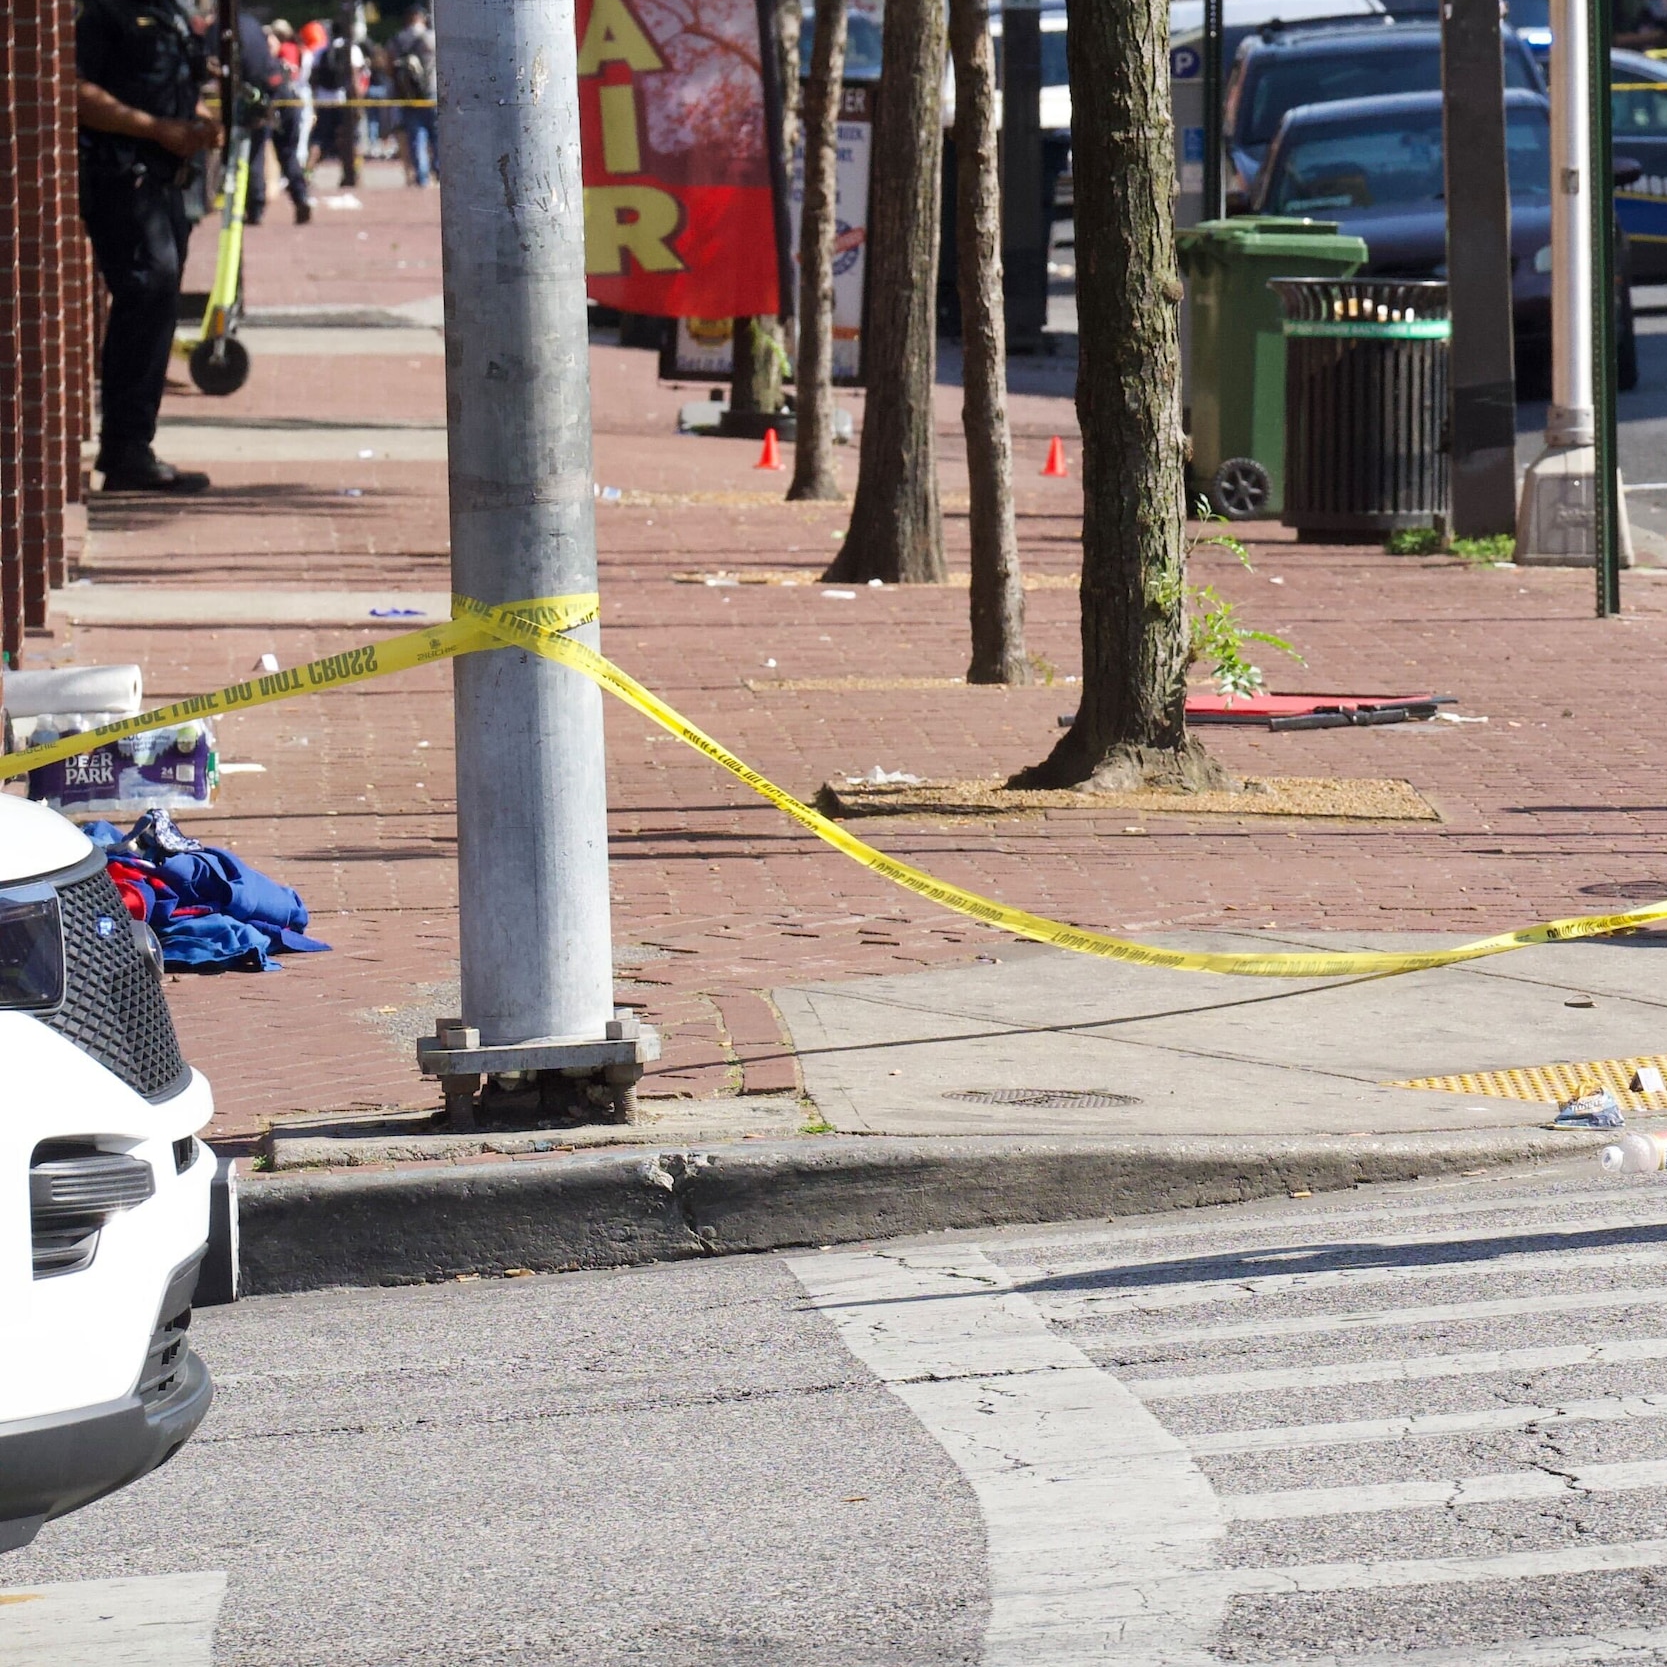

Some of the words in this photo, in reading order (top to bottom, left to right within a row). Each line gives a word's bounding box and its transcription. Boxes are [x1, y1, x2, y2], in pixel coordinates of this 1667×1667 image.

[1175, 52, 1194, 75] P
[65, 750, 114, 768] DEER
[65, 767, 115, 786] PARK
[160, 766, 174, 777] 24
